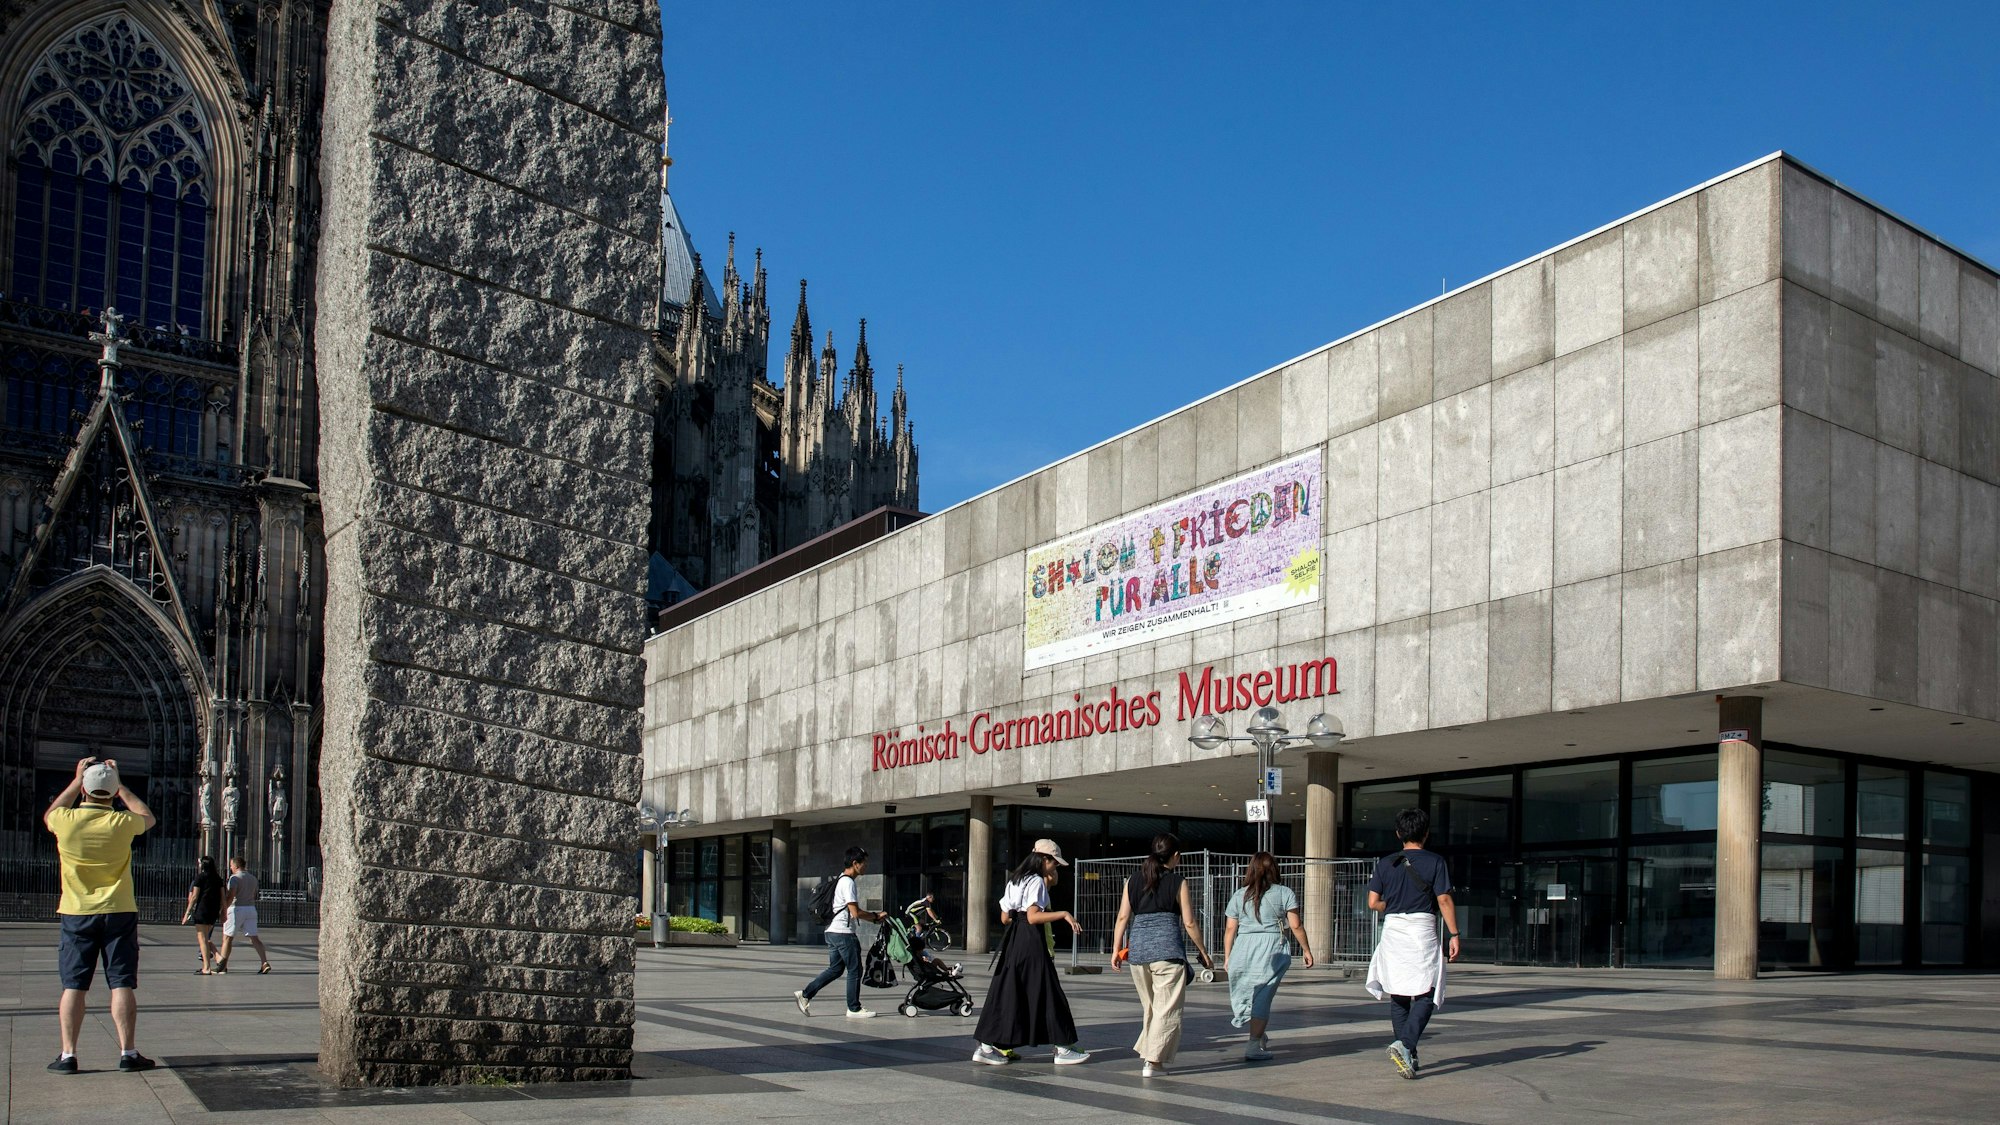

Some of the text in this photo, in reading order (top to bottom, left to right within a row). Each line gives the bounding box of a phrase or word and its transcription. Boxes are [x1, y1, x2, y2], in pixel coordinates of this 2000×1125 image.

[1291, 558, 1318, 575] SHALOM
[1294, 565, 1316, 580] SELFIE
[1095, 551, 1222, 622] FÜR ALLE
[1101, 628, 1117, 639] WIR
[1117, 621, 1146, 636] ZEIGEN
[1146, 602, 1219, 628] ZUSAMMENHALT!
[873, 657, 1337, 770] Römisch-Germanisches Museum
